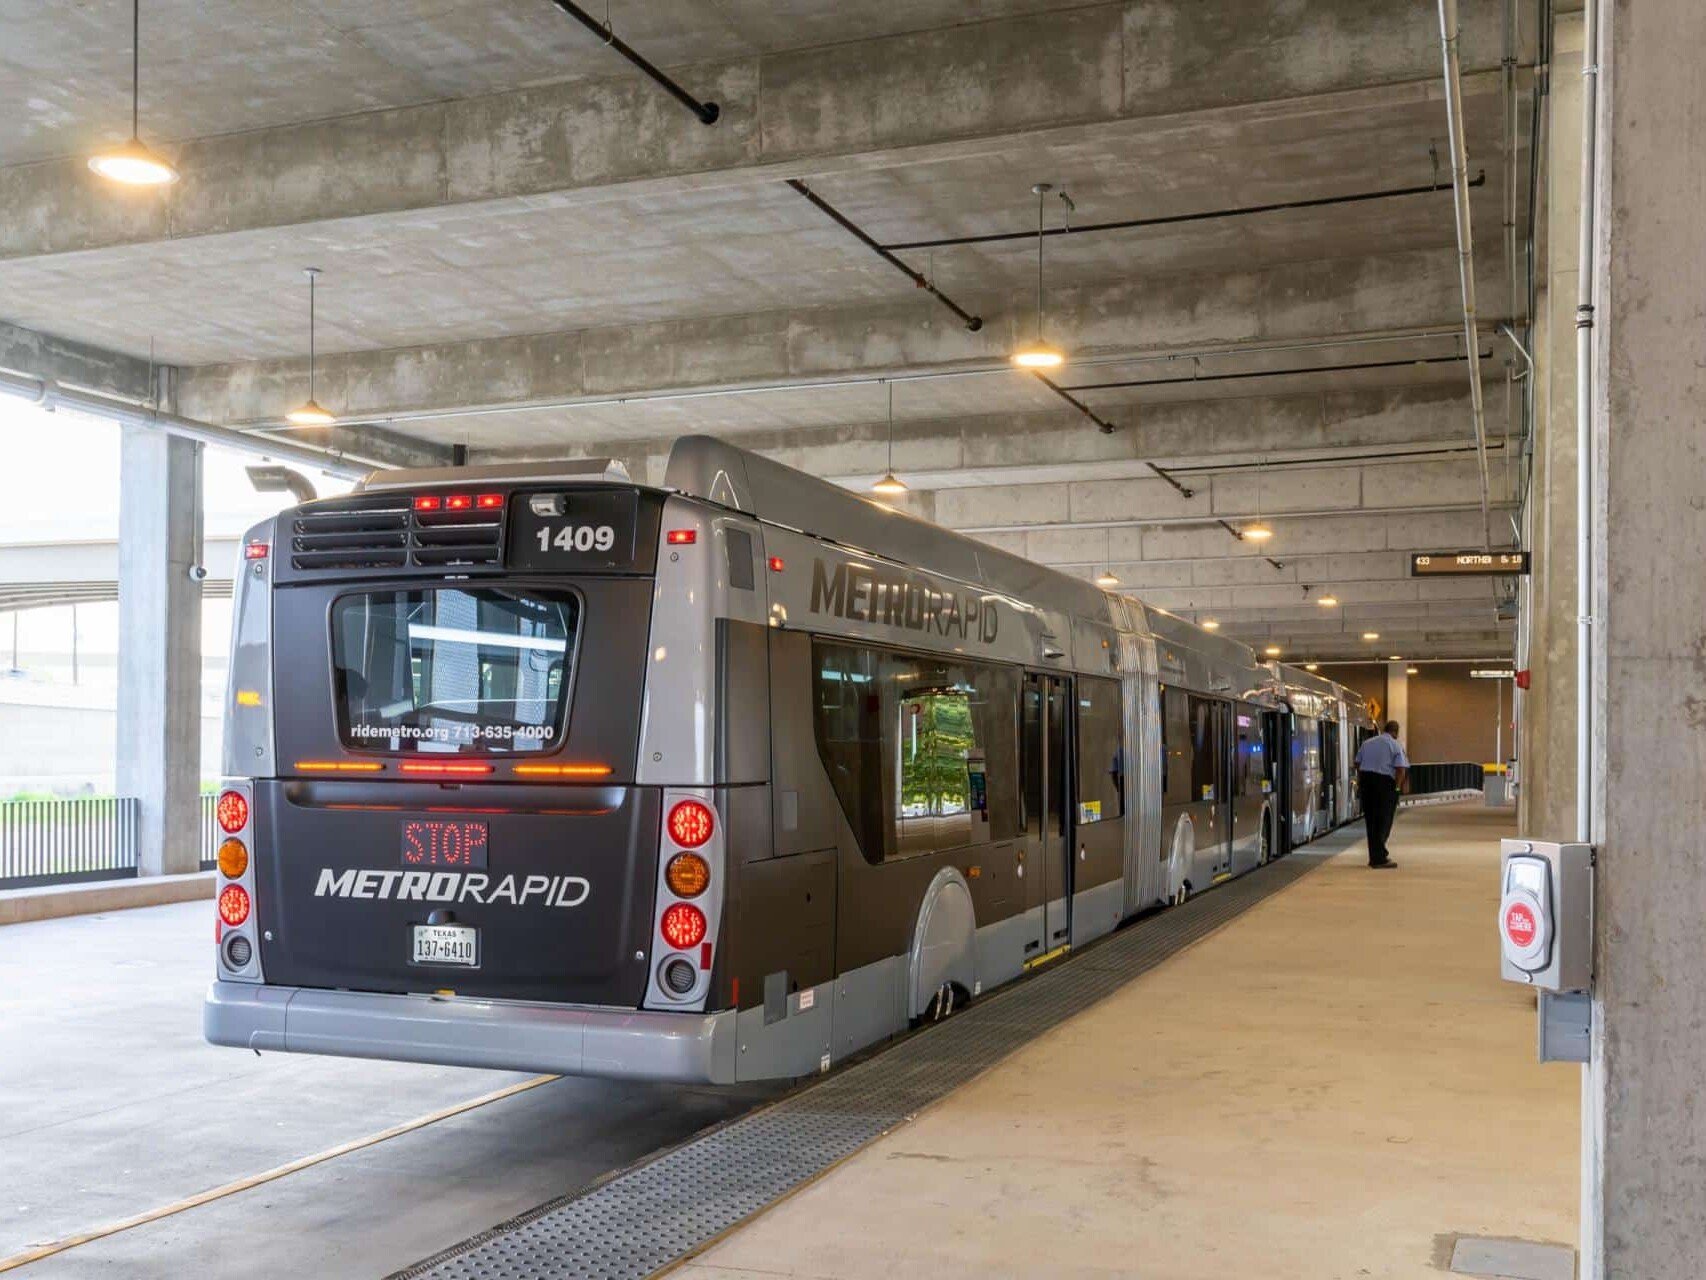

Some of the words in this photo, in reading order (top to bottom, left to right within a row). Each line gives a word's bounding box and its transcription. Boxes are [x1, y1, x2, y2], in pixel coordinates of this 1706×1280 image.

[536, 526, 615, 552] 1409
[810, 557, 998, 645] METRORAPID
[351, 724, 449, 740] ridemetro.org
[454, 725, 554, 740] 713-635-4000
[405, 822, 488, 865] STOP
[314, 868, 590, 907] METRORAPID
[433, 929, 457, 938] TEXAS
